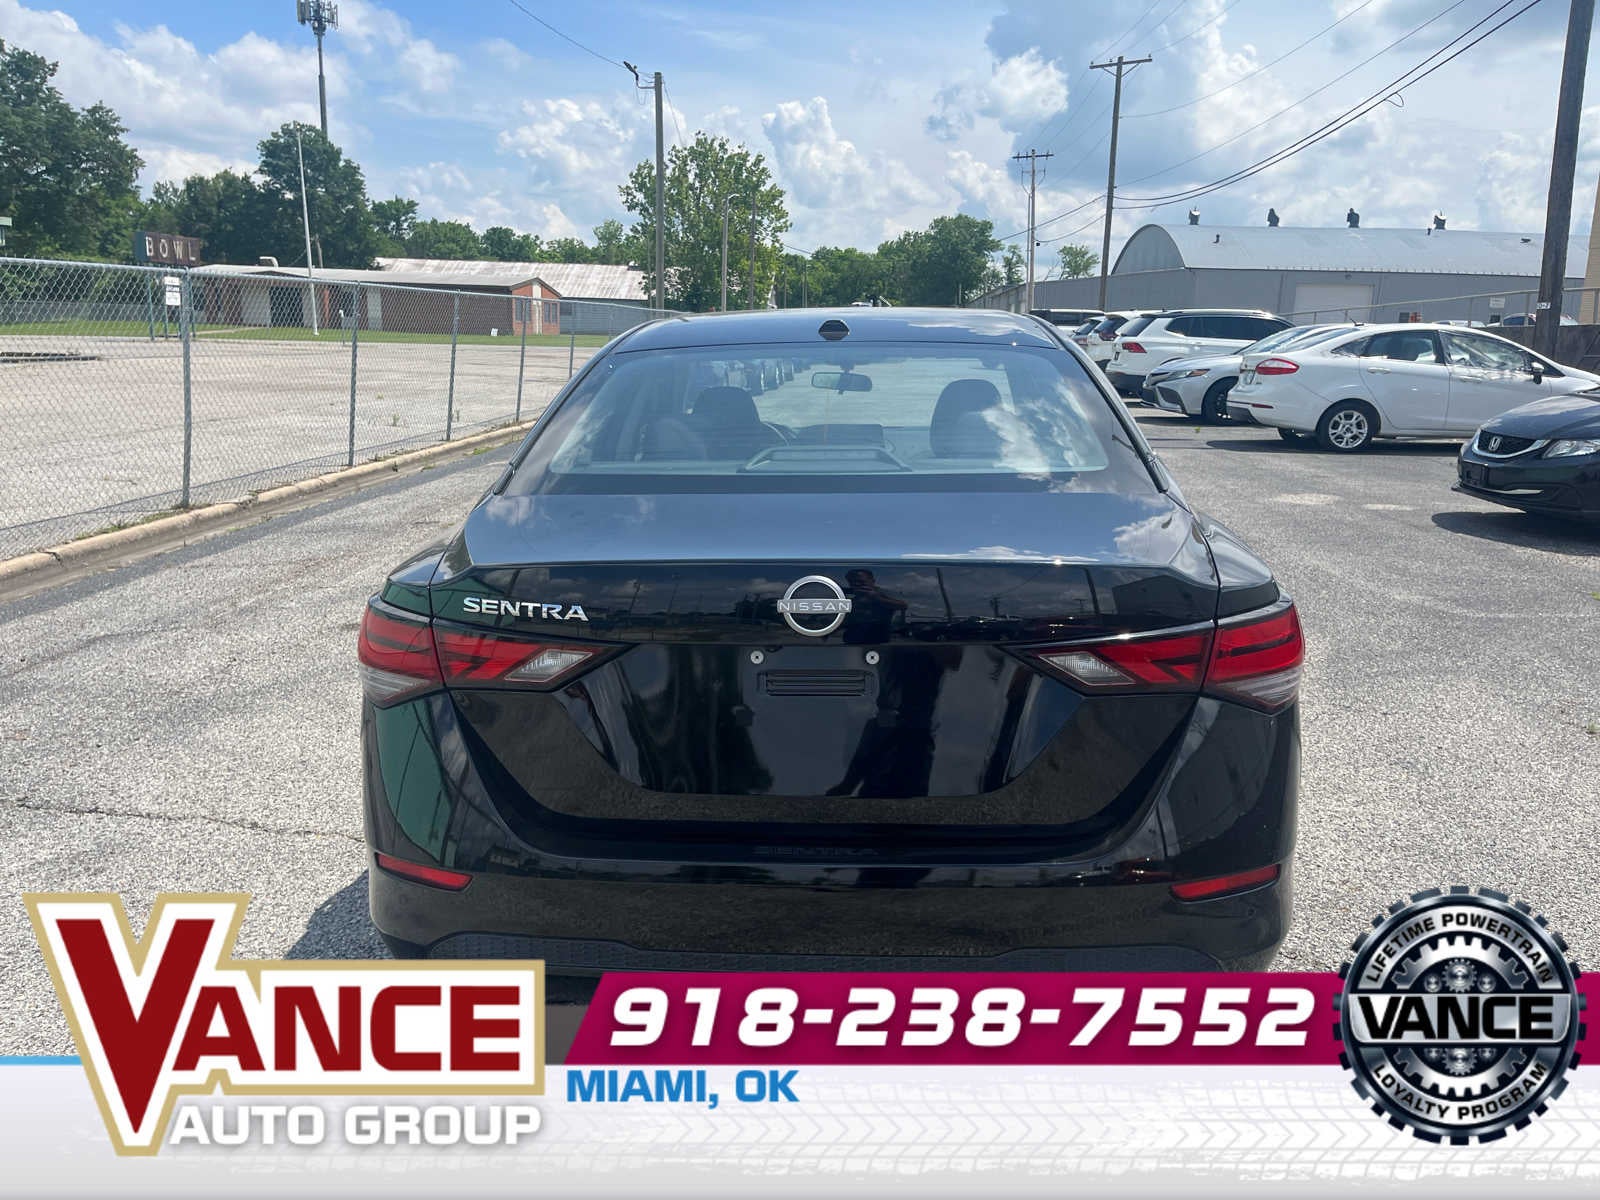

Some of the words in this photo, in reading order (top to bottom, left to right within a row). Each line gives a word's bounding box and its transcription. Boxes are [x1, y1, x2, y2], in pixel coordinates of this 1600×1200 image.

[145, 236, 197, 261] BOWL
[463, 596, 590, 622] SENTRA
[779, 602, 850, 611] NISSAN
